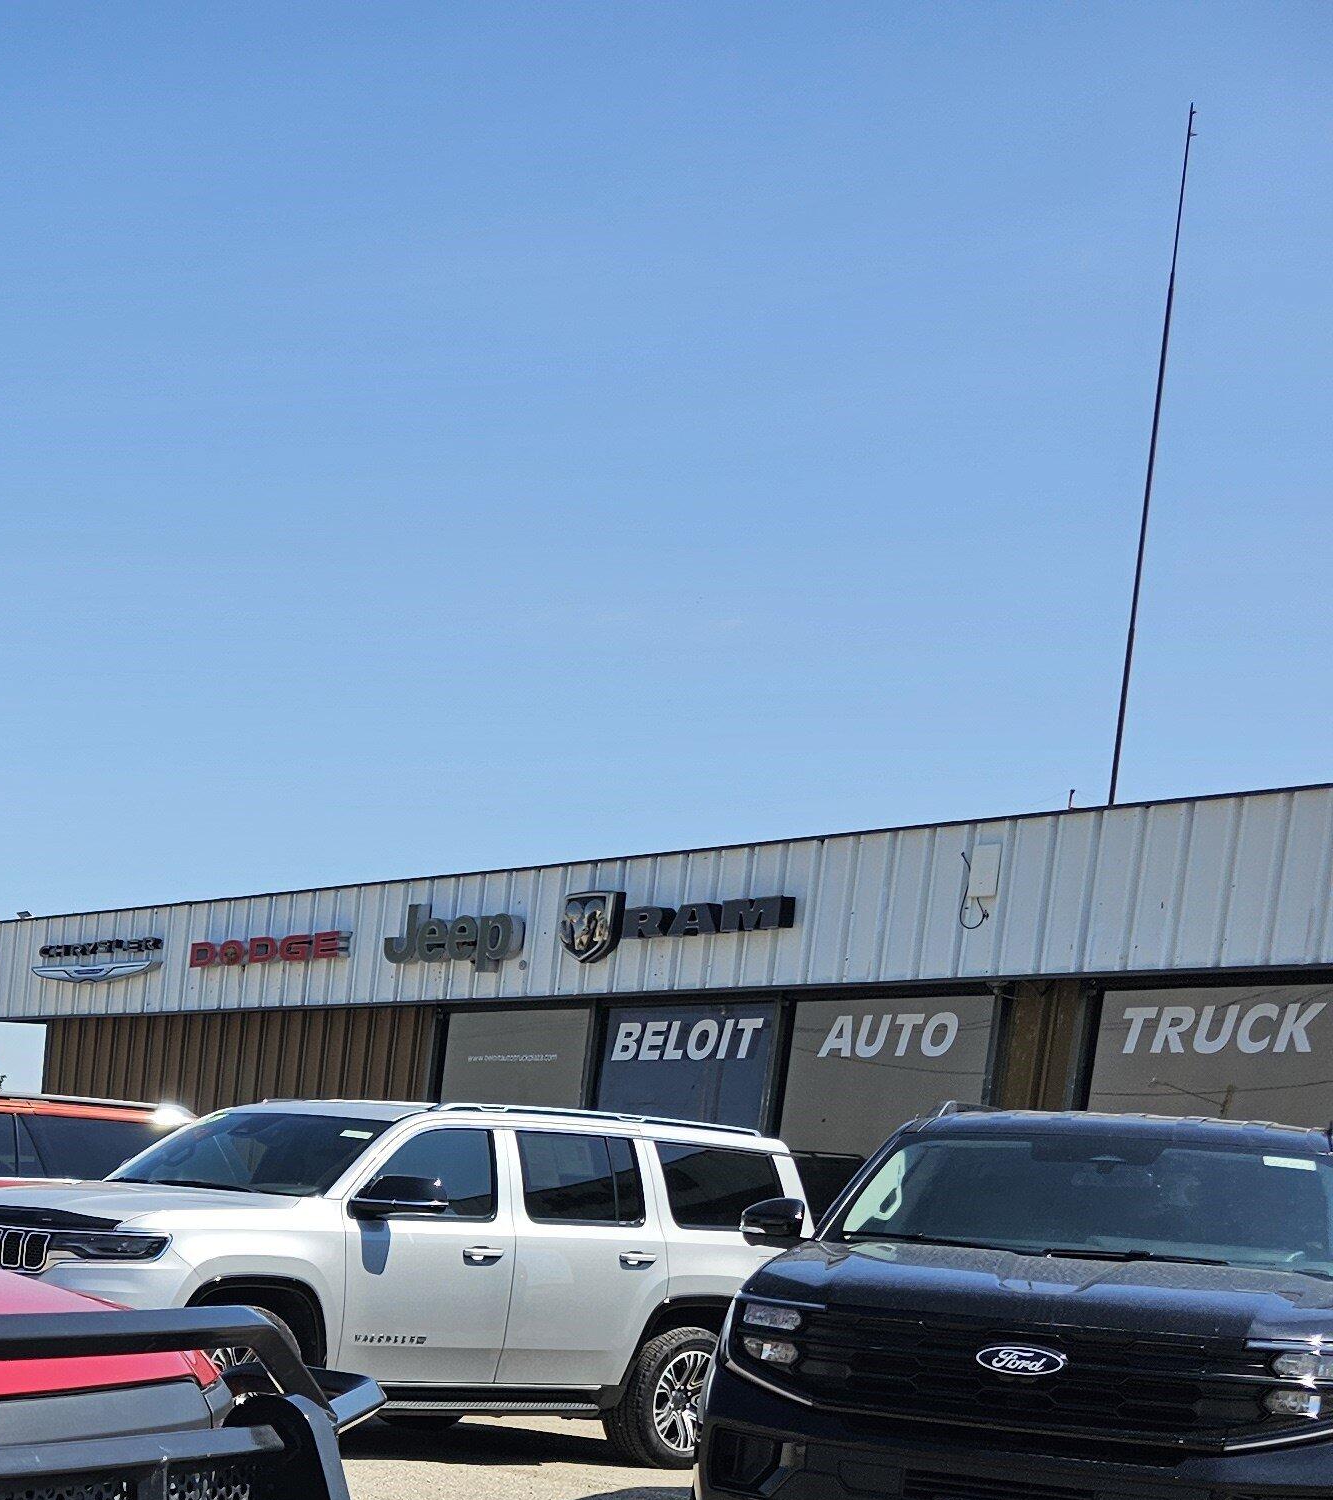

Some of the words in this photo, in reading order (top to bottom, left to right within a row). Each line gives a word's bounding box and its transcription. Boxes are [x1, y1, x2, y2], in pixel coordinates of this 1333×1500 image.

[622, 895, 793, 939] RAM
[39, 937, 162, 957] CHRYSLER
[189, 931, 347, 968] DODGE
[384, 904, 520, 973] Jeep
[611, 1018, 764, 1061] BELOIT
[817, 1012, 959, 1058] AUTO
[1122, 1003, 1327, 1054] TRUCK
[992, 1350, 1047, 1371] Ford
